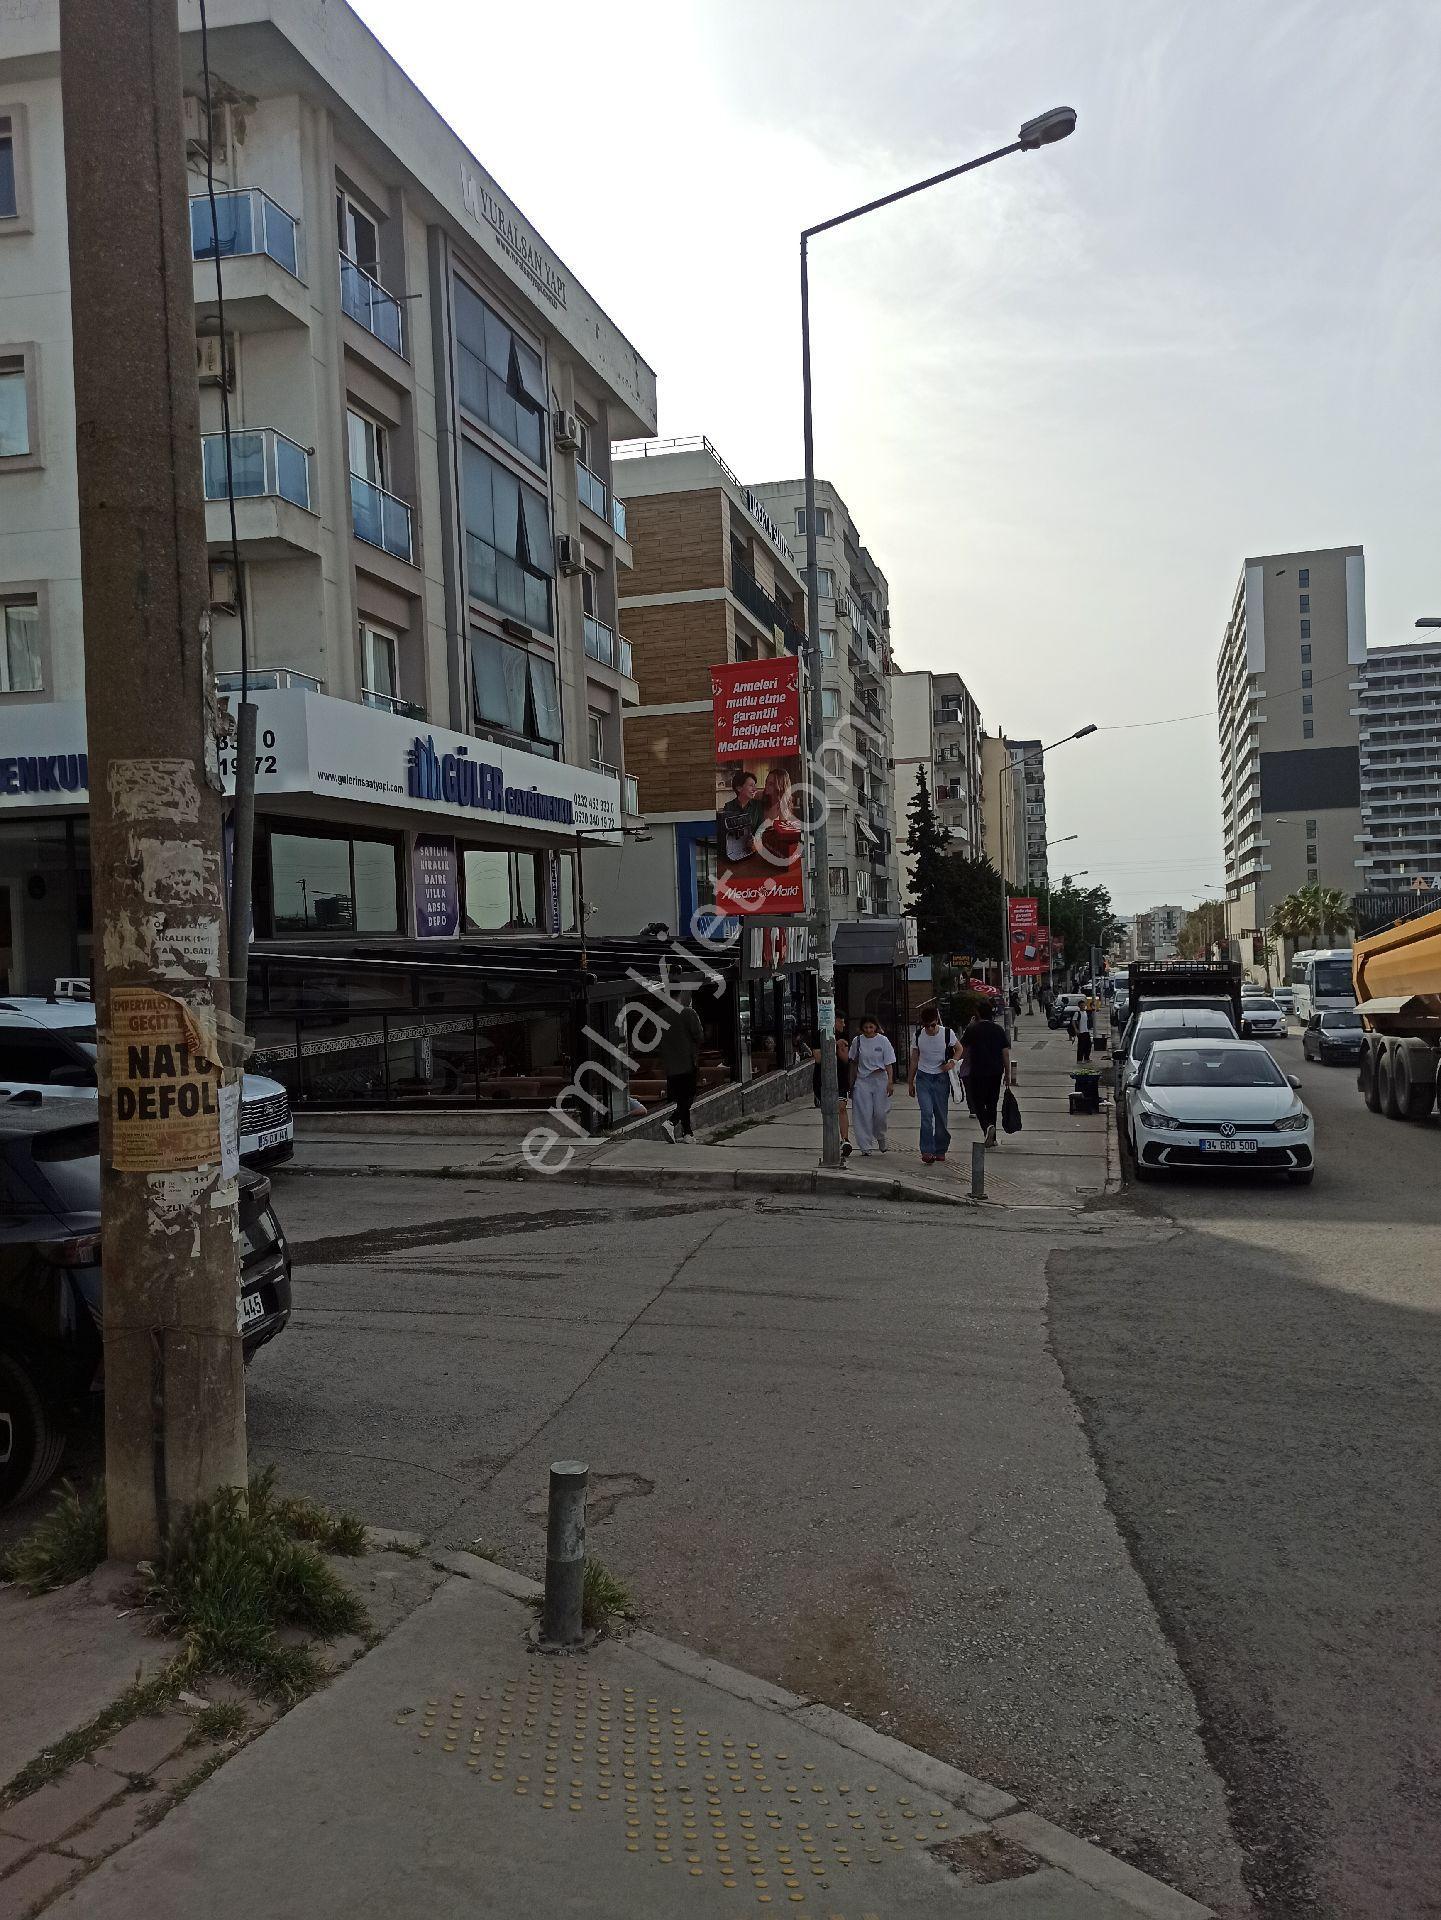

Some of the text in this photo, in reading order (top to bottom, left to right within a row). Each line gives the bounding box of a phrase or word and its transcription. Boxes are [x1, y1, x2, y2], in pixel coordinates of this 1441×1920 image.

[733, 677, 778, 694] Anneleri
[726, 693, 786, 709] mutlu etme
[732, 707, 778, 725] garantili
[732, 721, 783, 737] hediyeler
[717, 734, 798, 753] MediaMarkt'ta!
[317, 770, 404, 794] www.gulerinsaatyapi.com
[442, 745, 504, 812] GÜLER
[420, 846, 448, 857] SATILIK
[721, 884, 800, 900] Media Markt
[426, 902, 447, 913] ARSA
[428, 915, 447, 927] DEPO
[1206, 1140, 1217, 1150] 34
[1239, 1141, 1256, 1151] 500
[243, 1295, 262, 1319] 445
